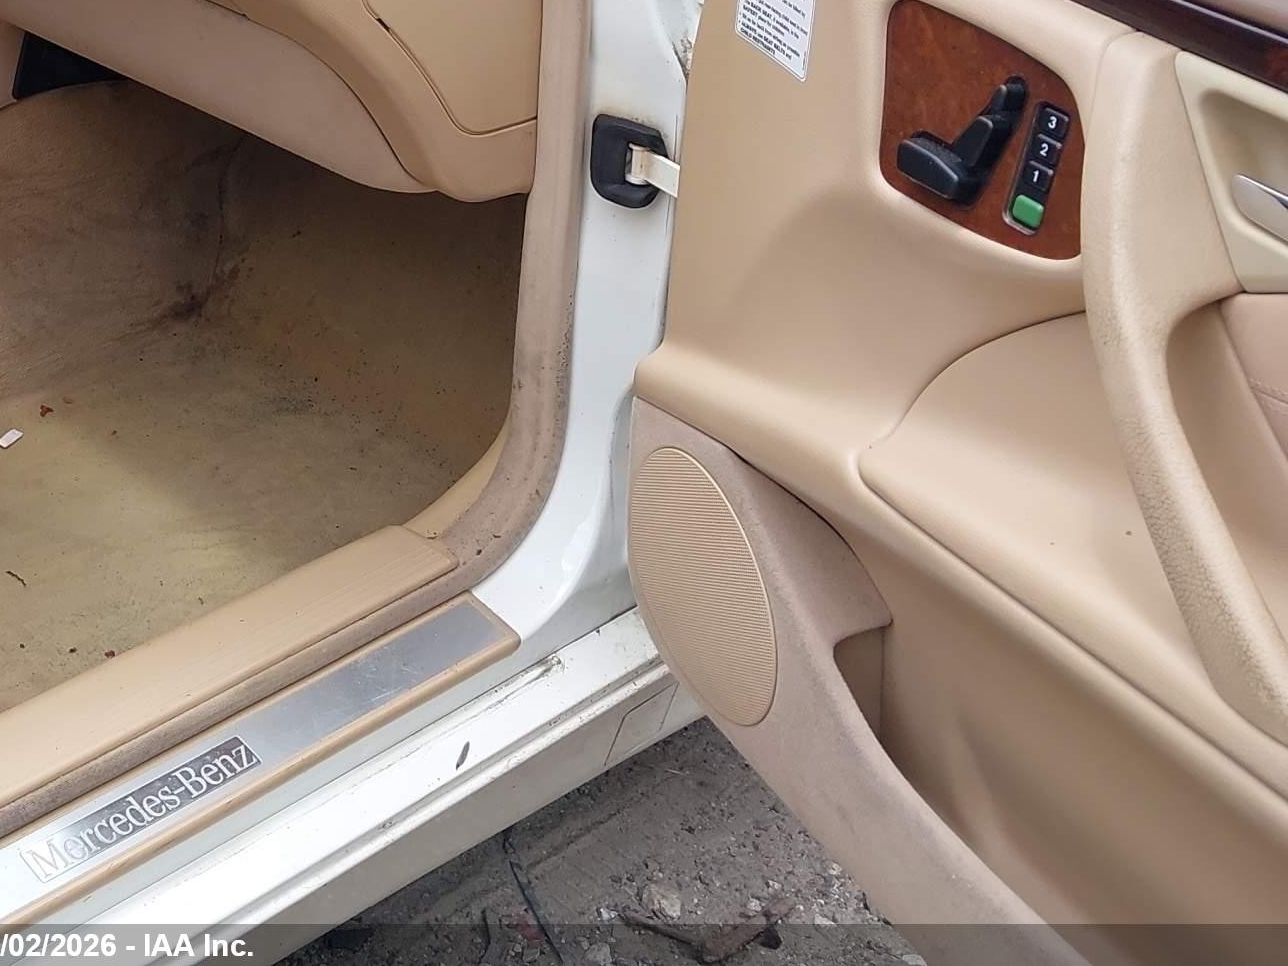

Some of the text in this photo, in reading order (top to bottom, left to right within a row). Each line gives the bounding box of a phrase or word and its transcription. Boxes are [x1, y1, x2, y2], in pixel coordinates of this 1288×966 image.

[1047, 116, 1057, 129] 3
[1040, 143, 1049, 156] 2
[1032, 170, 1040, 182] 1
[27, 744, 256, 878] Mercedes-Benz
